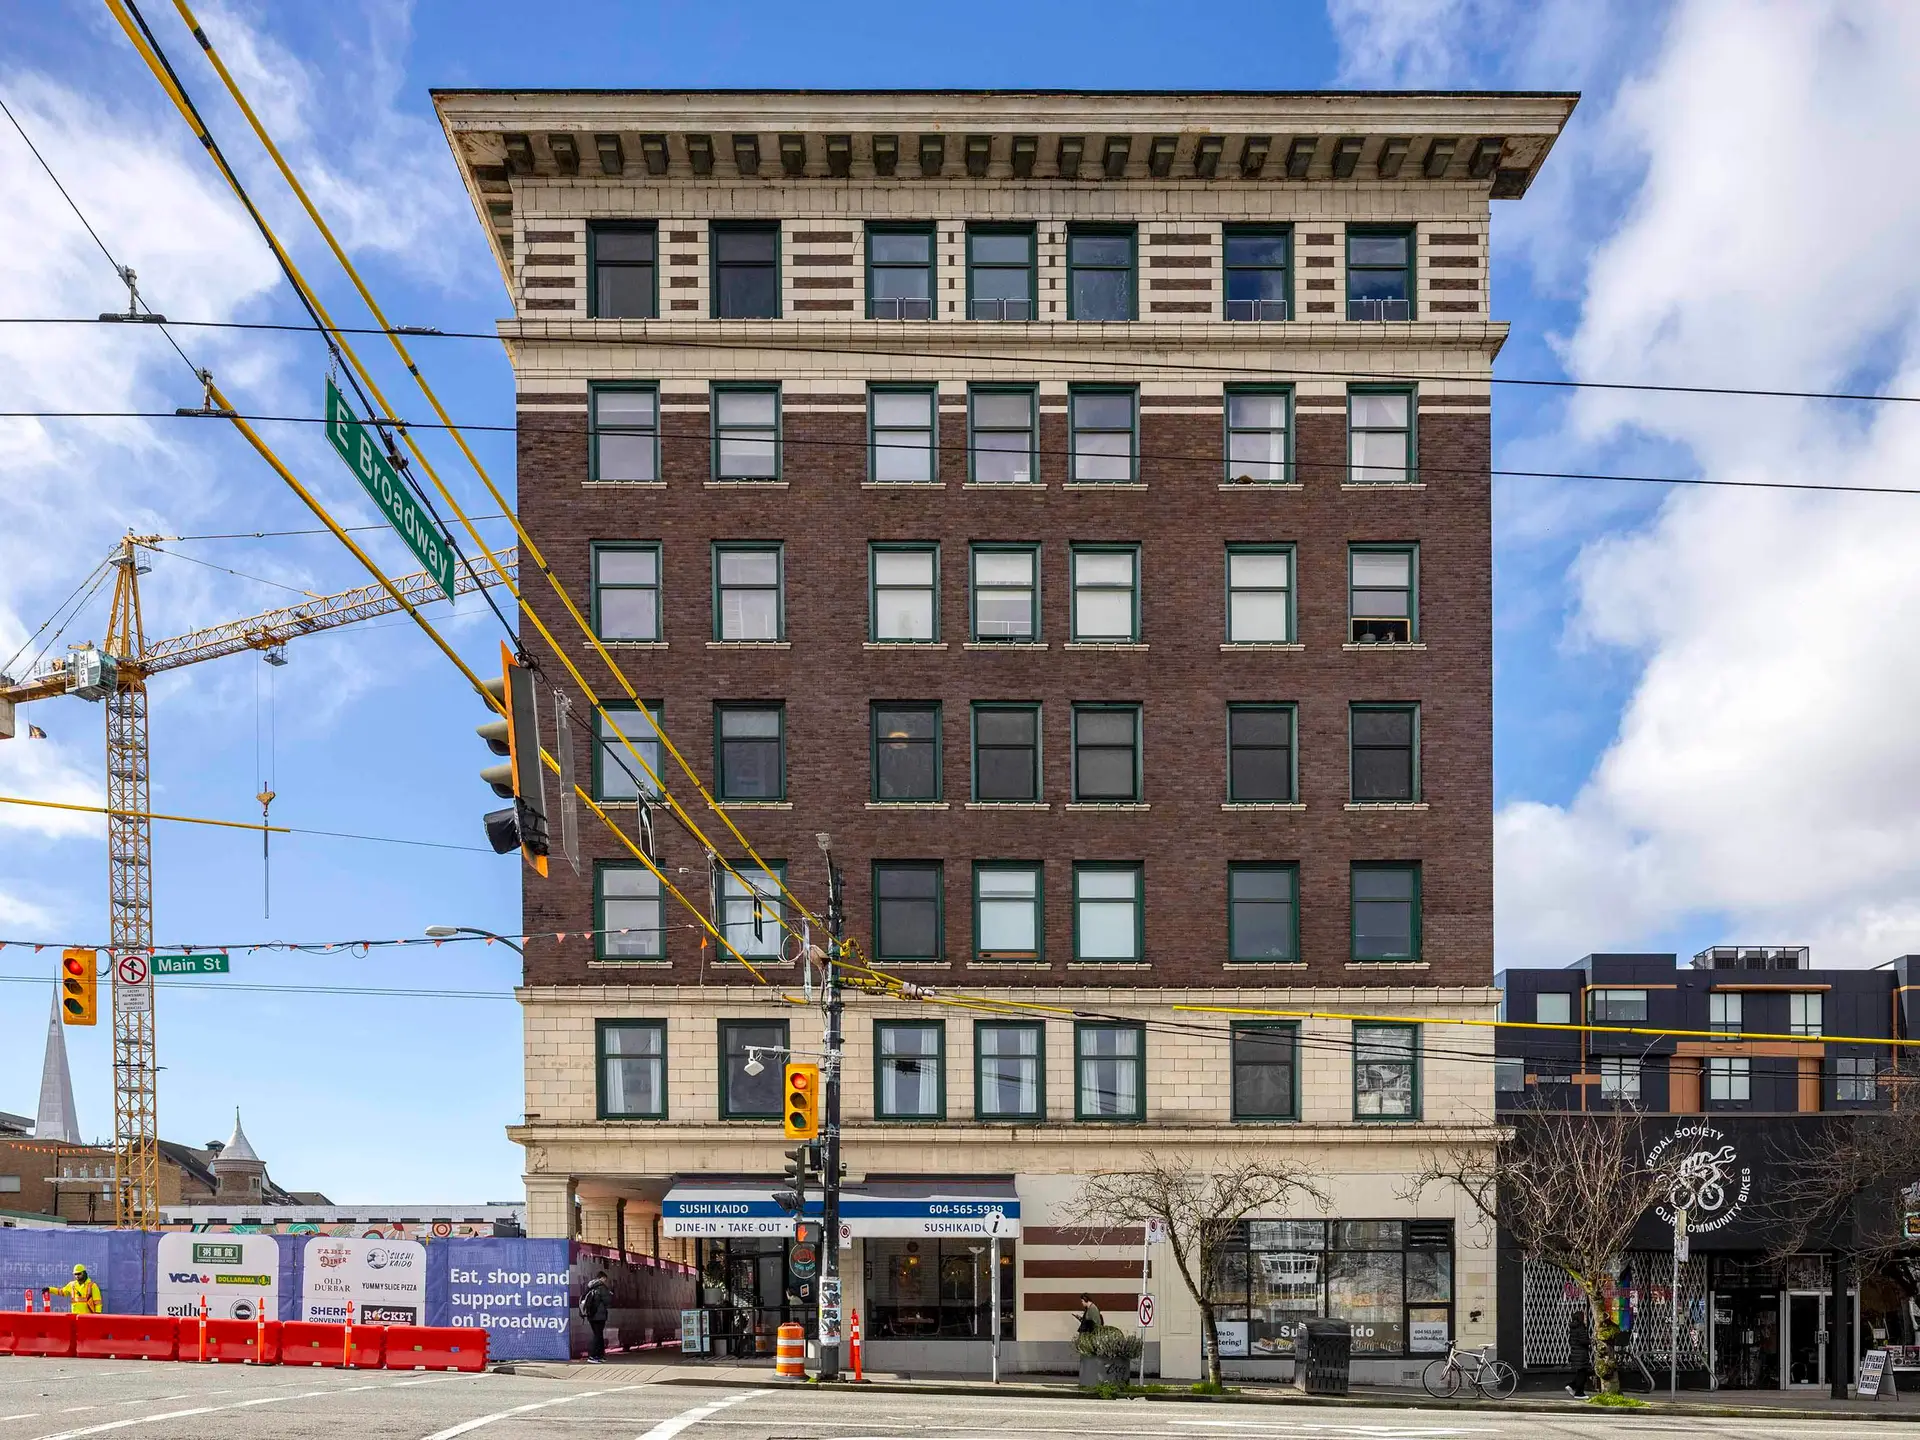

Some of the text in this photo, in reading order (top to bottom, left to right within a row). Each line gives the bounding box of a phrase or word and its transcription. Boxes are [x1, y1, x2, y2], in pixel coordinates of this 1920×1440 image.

[336, 399, 448, 585] E Broadway
[158, 957, 221, 972] Main St
[1646, 1126, 1724, 1167] PEDAL SOCIETY
[1655, 1167, 1751, 1233] OUR OMMUNITY BIKES
[679, 1204, 749, 1214] SUSHI KAIDO
[929, 1204, 1004, 1214] 604-565-5939
[675, 1223, 781, 1232] DINE-IN TAKE-OUT
[389, 1252, 414, 1260] SUSHI
[320, 1256, 347, 1268] DINER
[389, 1260, 413, 1268] KAIDO
[168, 1273, 200, 1283] VCA
[450, 1268, 570, 1288] Eat, shop and
[314, 1284, 351, 1292] DURBAR
[361, 1282, 385, 1290] YUMMY
[384, 1283, 400, 1291] SLICE
[451, 1291, 568, 1310] support local
[309, 1316, 356, 1325] CONVENIENE
[364, 1309, 414, 1322] ROCKET
[451, 1313, 569, 1333] on Broadway
[1350, 1324, 1375, 1337] ido
[1218, 1338, 1242, 1347] tering!
[1867, 1355, 1884, 1363] FRIENDS
